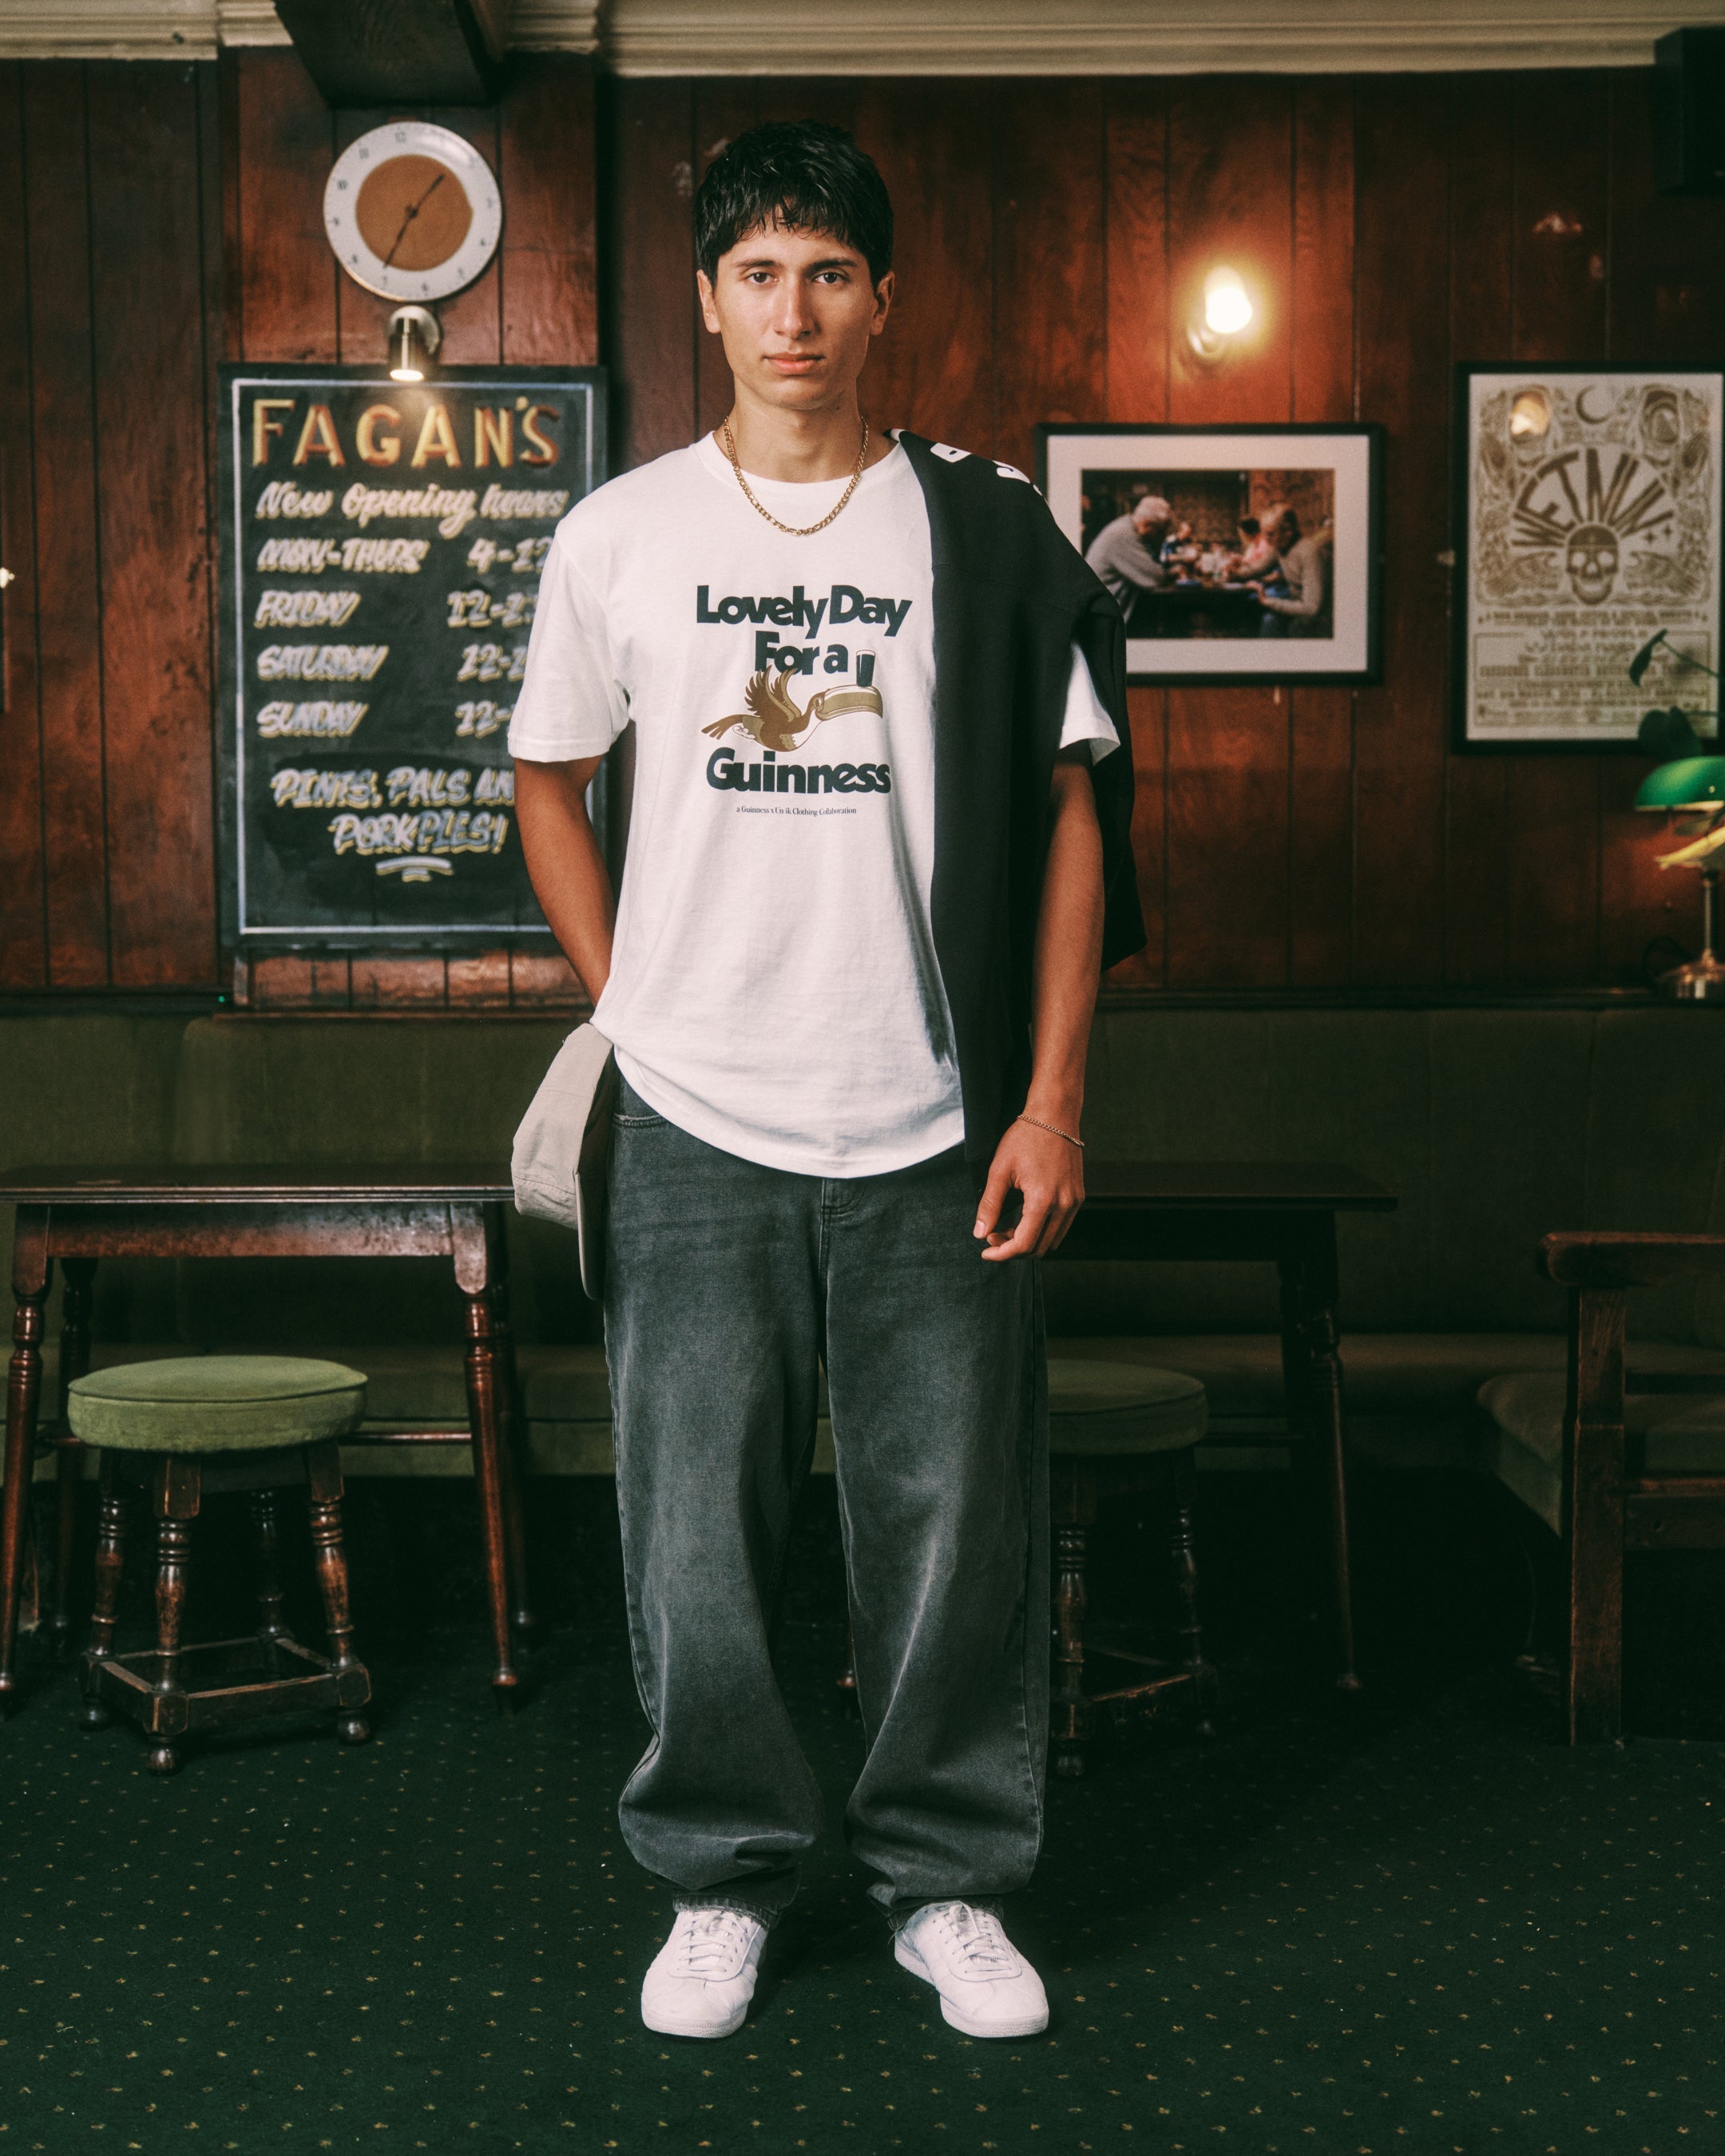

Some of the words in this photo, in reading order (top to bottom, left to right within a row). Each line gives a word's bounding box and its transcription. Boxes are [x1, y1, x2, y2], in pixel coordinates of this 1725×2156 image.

[252, 397, 561, 468] FAGAN'S
[255, 481, 334, 519] New
[341, 482, 478, 540] Opening
[480, 483, 569, 518] hours
[253, 590, 361, 628] FRIDAY
[696, 585, 829, 640] Lovely
[829, 585, 913, 637] Day
[256, 644, 390, 682] SATURDAY
[755, 630, 820, 676] For
[823, 644, 848, 674] a
[256, 700, 369, 738] SUNDAY
[385, 766, 471, 807] PALS
[474, 767, 515, 807] AN
[706, 747, 891, 794] Guinness
[741, 805, 770, 814] Guinness
[792, 807, 818, 817] Clothing
[819, 807, 857, 815] Collaboration
